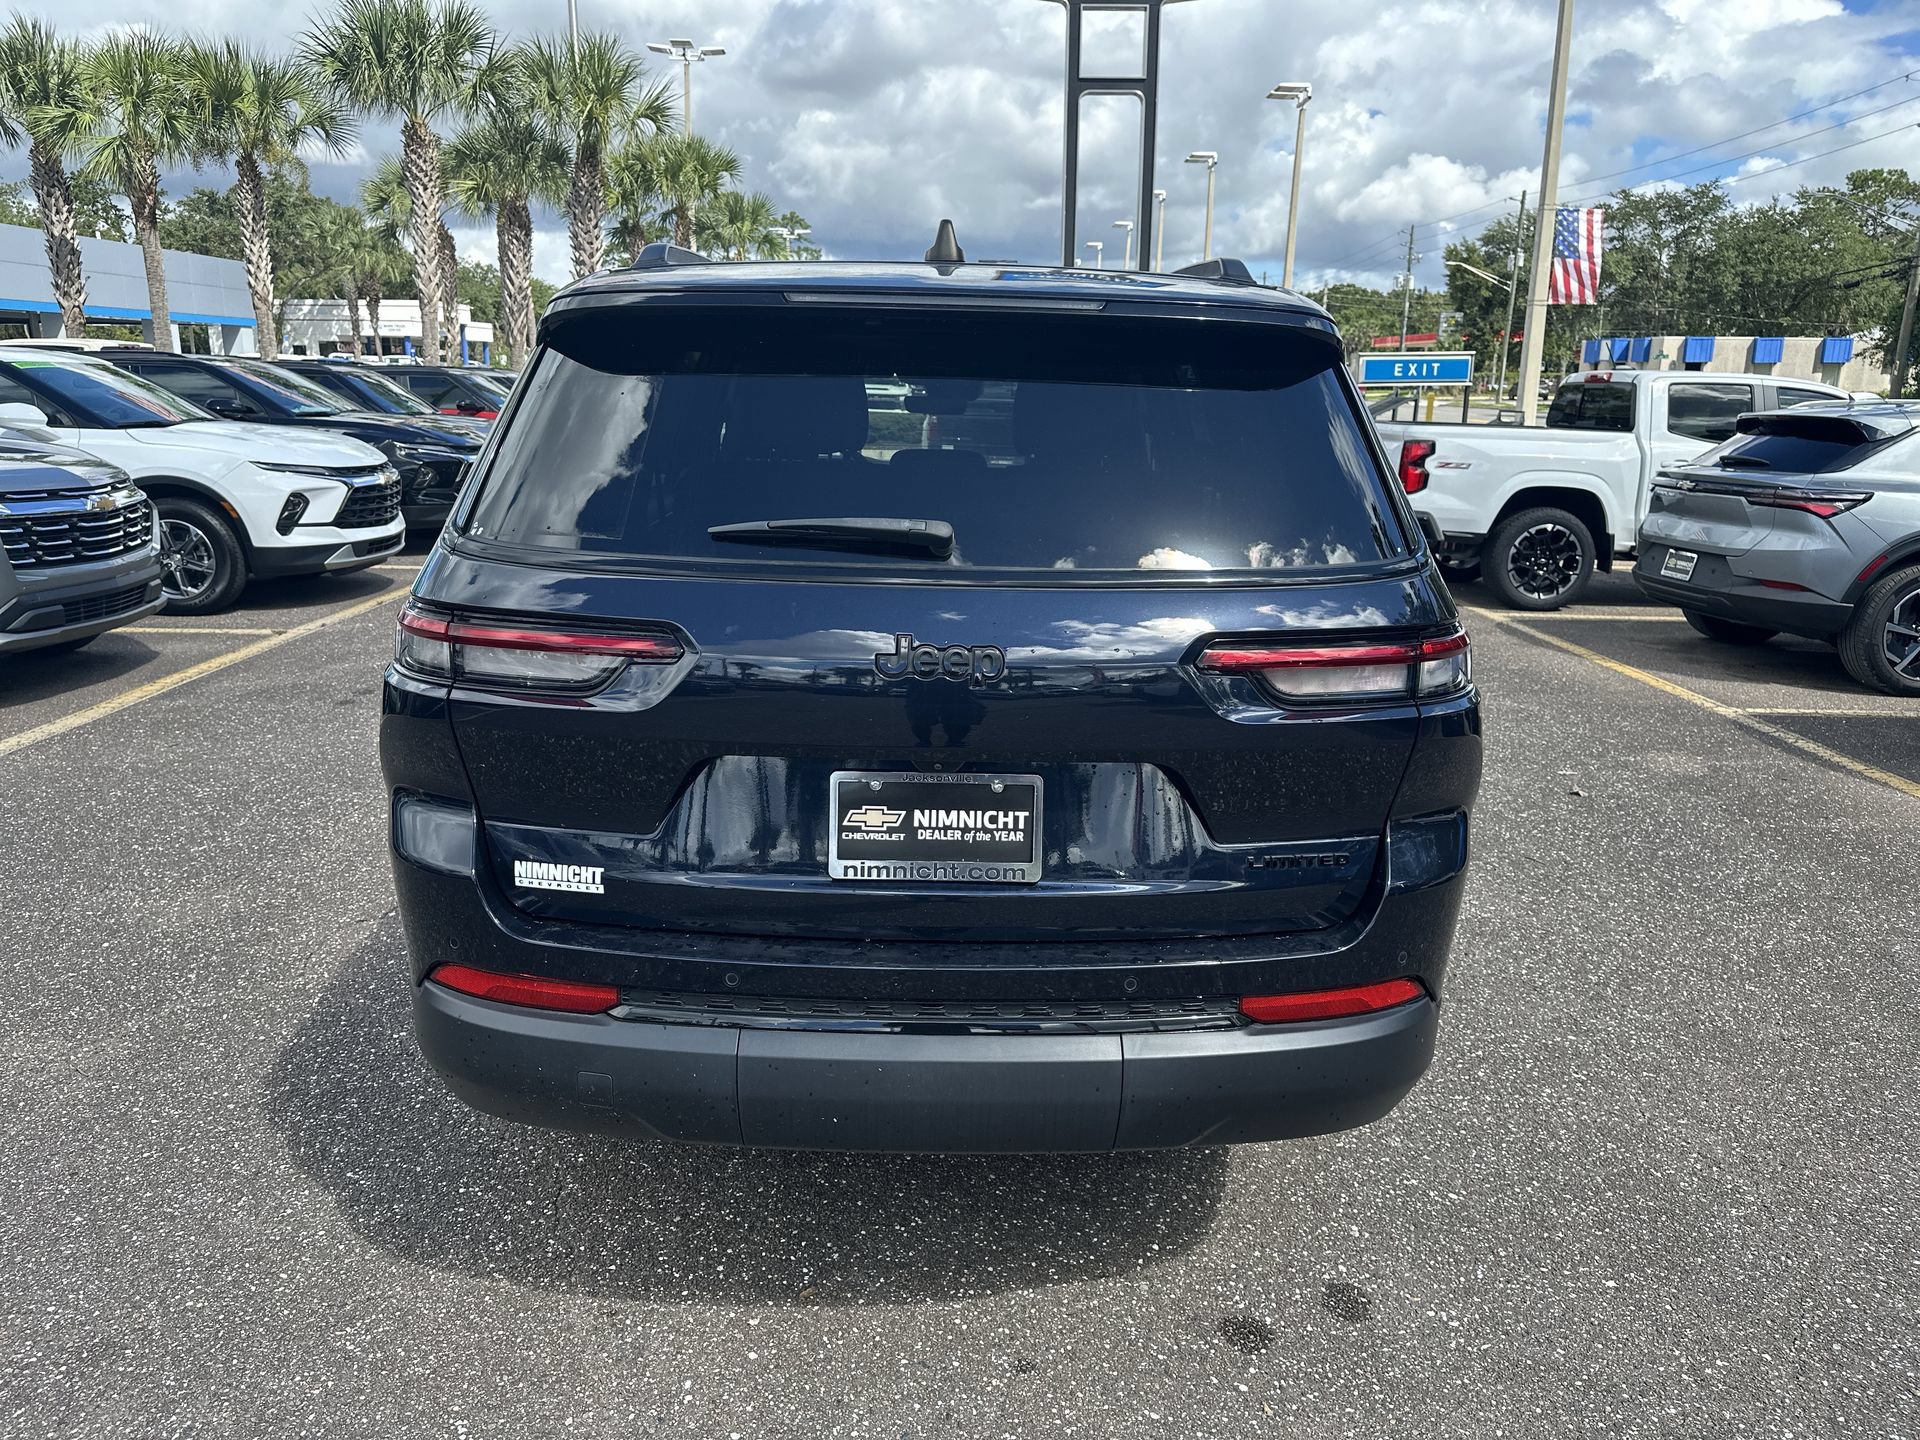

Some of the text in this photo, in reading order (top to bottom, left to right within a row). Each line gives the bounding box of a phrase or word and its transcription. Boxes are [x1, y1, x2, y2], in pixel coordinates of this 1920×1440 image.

[1394, 363, 1440, 376] EXIT
[875, 633, 1005, 689] Jeep
[902, 774, 973, 783] Jacksonville
[913, 809, 1030, 830] NIMNICHT
[842, 832, 906, 841] CHEVROLET
[917, 829, 1024, 843] DEALER of the YEAR
[1246, 853, 1350, 870] LIMITED
[514, 860, 605, 885] NIMNICHT
[843, 861, 1026, 881] nimnicht.com
[518, 879, 600, 891] CHEVROLET
